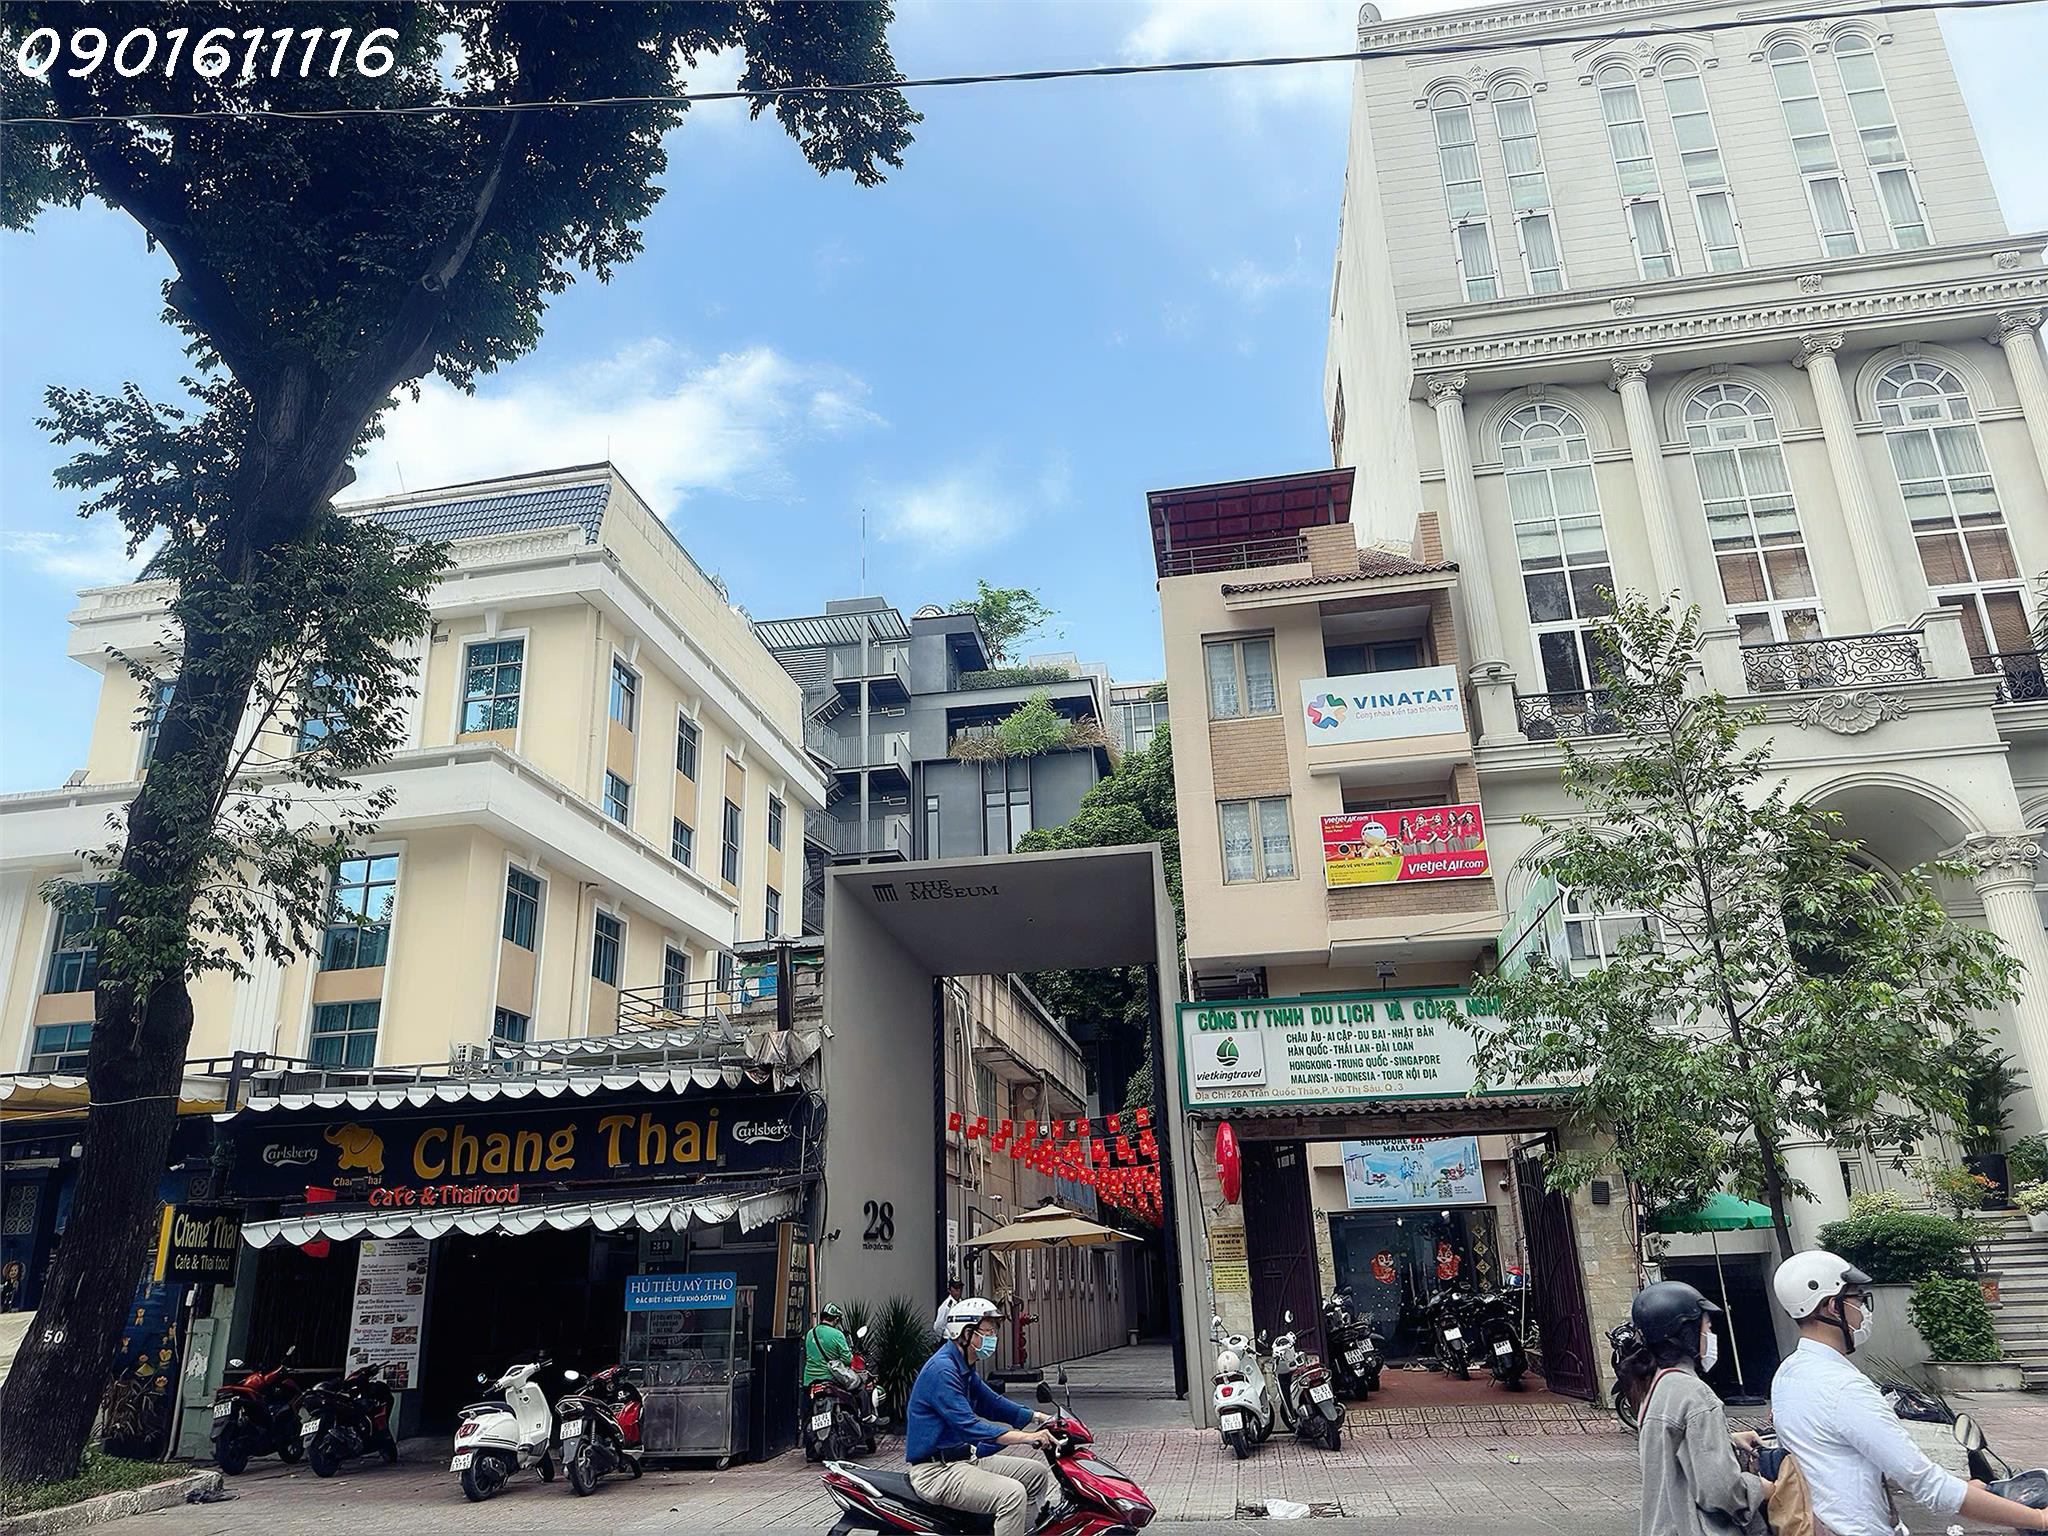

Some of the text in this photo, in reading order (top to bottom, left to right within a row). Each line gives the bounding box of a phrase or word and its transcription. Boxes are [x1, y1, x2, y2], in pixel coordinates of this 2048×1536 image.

[1353, 688, 1454, 709] VINATAT
[905, 879, 951, 890] THE
[911, 886, 1000, 901] MUSEUM
[1198, 1008, 1237, 1031] CÔNG
[1240, 1010, 1259, 1028] TY
[1264, 1007, 1304, 1027] TNHH
[1311, 1005, 1333, 1025] DU
[1337, 1003, 1374, 1027] LỊCH
[1384, 999, 1405, 1021] VÀ
[1286, 1025, 1435, 1043] CHÂU ÂU AI CẬP DU BAI NHẬT BẢN
[1287, 1041, 1414, 1056] HÀN QUỐC THÁI LAN ĐÀI LOAN
[1289, 1053, 1441, 1071] HONGKONG TRUNG QUỐC SINGAPORE
[1196, 1068, 1262, 1081] vietkingtravel
[1291, 1067, 1438, 1084] MALAYSIA INDONESIA TOUR NỘI ĐỊA
[732, 1118, 793, 1144] Carlsberg
[413, 1107, 720, 1180] Chang Thai
[1383, 1144, 1425, 1153] MALAYSIA
[262, 1144, 318, 1166] Carlsberg
[420, 1185, 439, 1206] &
[863, 1200, 894, 1242] 28
[174, 1213, 239, 1249] Chang Thai
[174, 1254, 191, 1270] Cafe
[191, 1254, 199, 1270] &
[631, 1278, 651, 1294] HỦ
[704, 1278, 734, 1291] THO
[43, 1329, 64, 1344] 50
